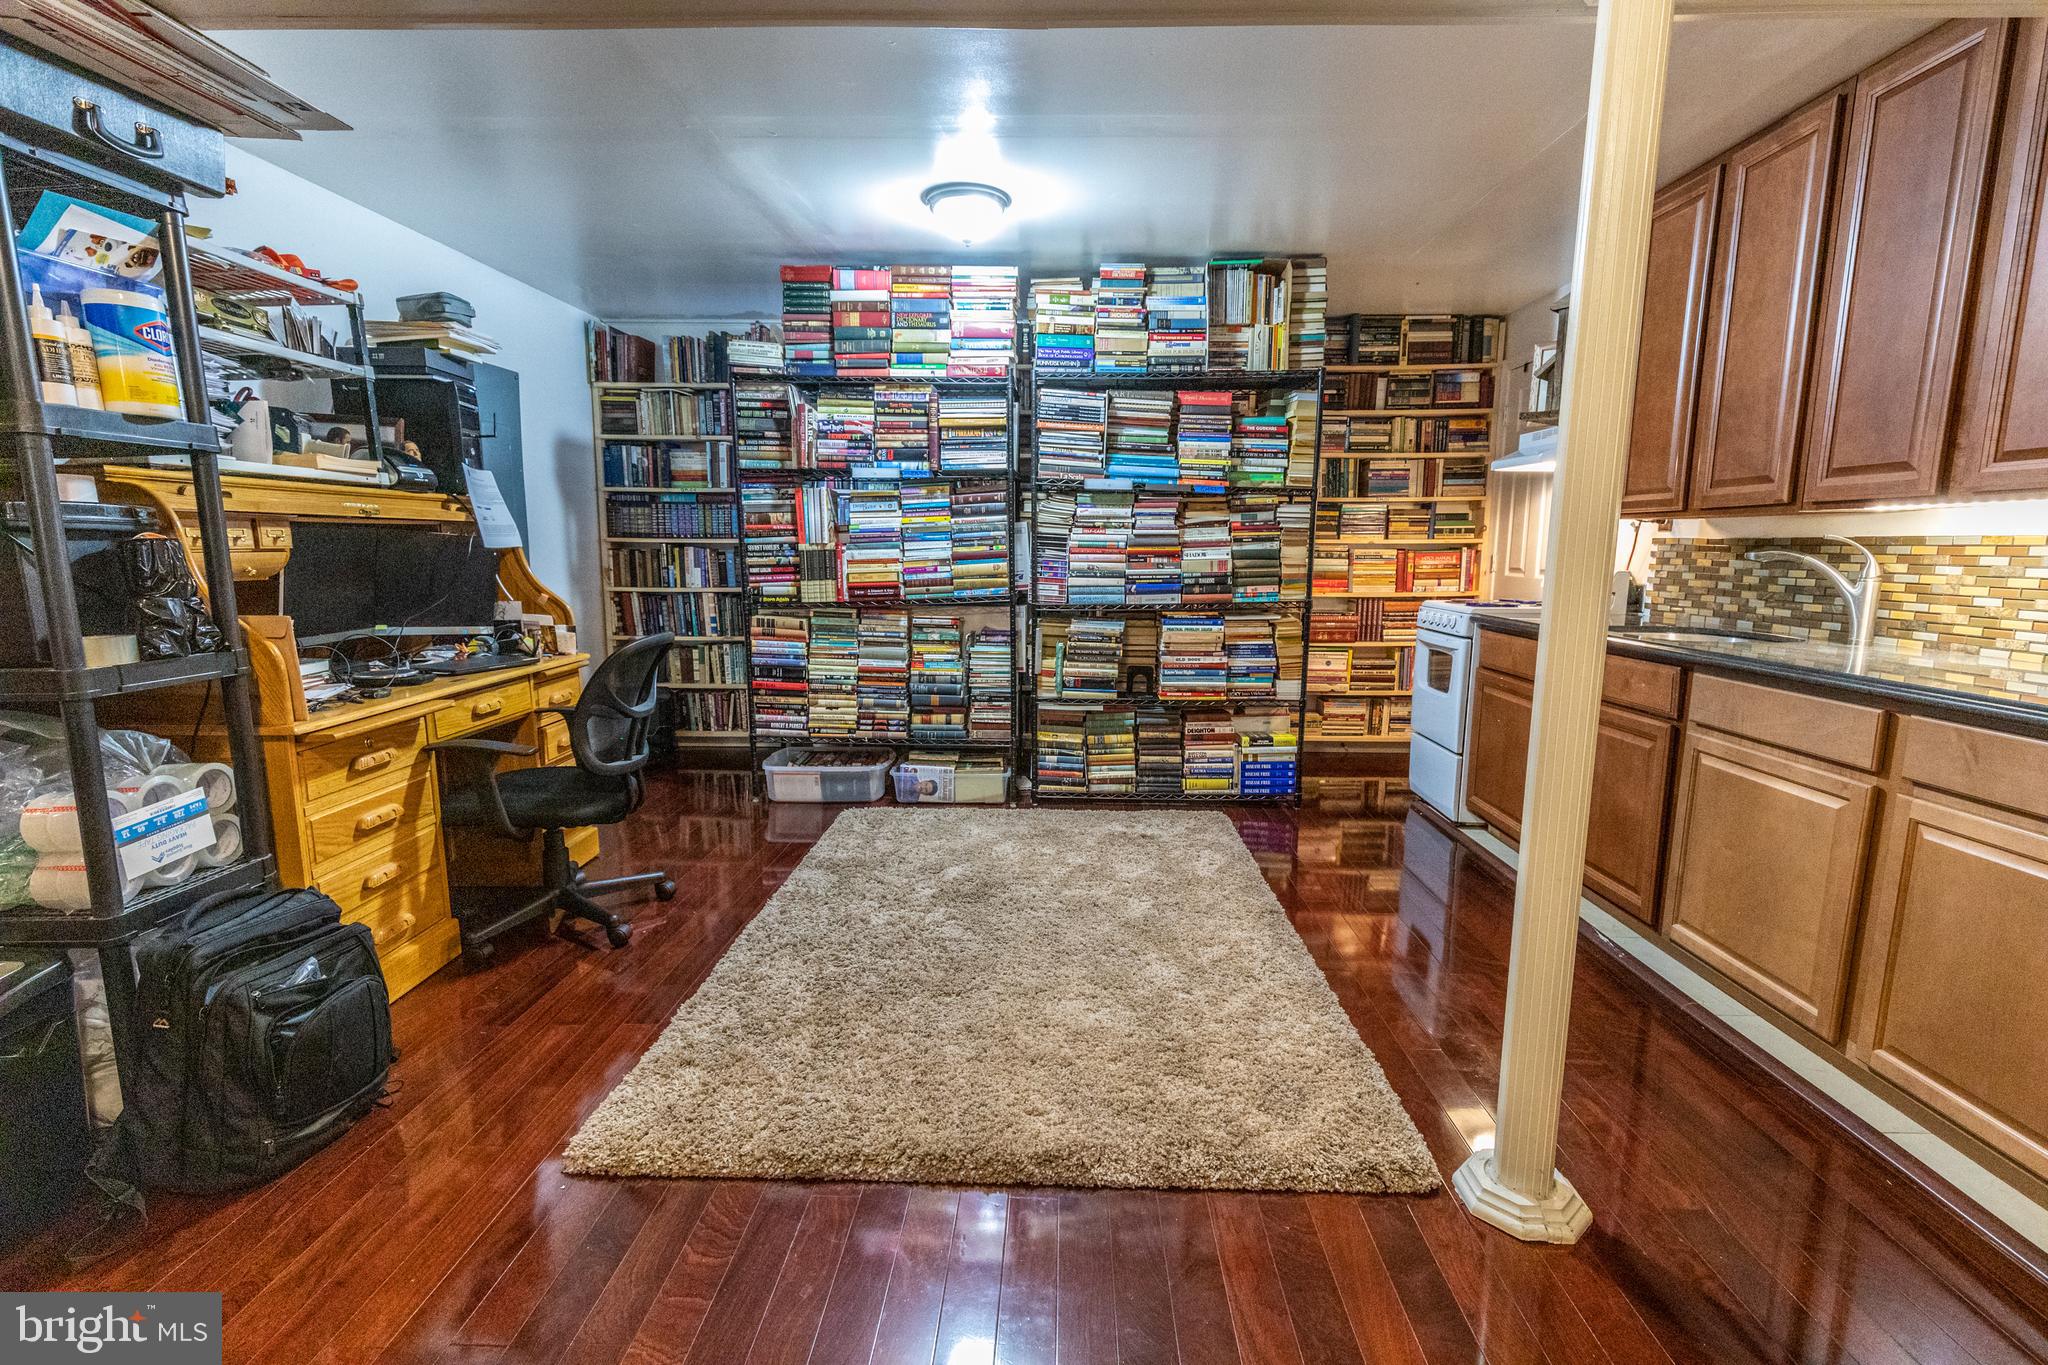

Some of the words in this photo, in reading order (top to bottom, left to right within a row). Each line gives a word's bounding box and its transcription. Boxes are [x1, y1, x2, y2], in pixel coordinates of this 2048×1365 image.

[143, 327, 170, 344] CLOR
[167, 831, 187, 843] HEAVY
[150, 839, 167, 850] DUTY
